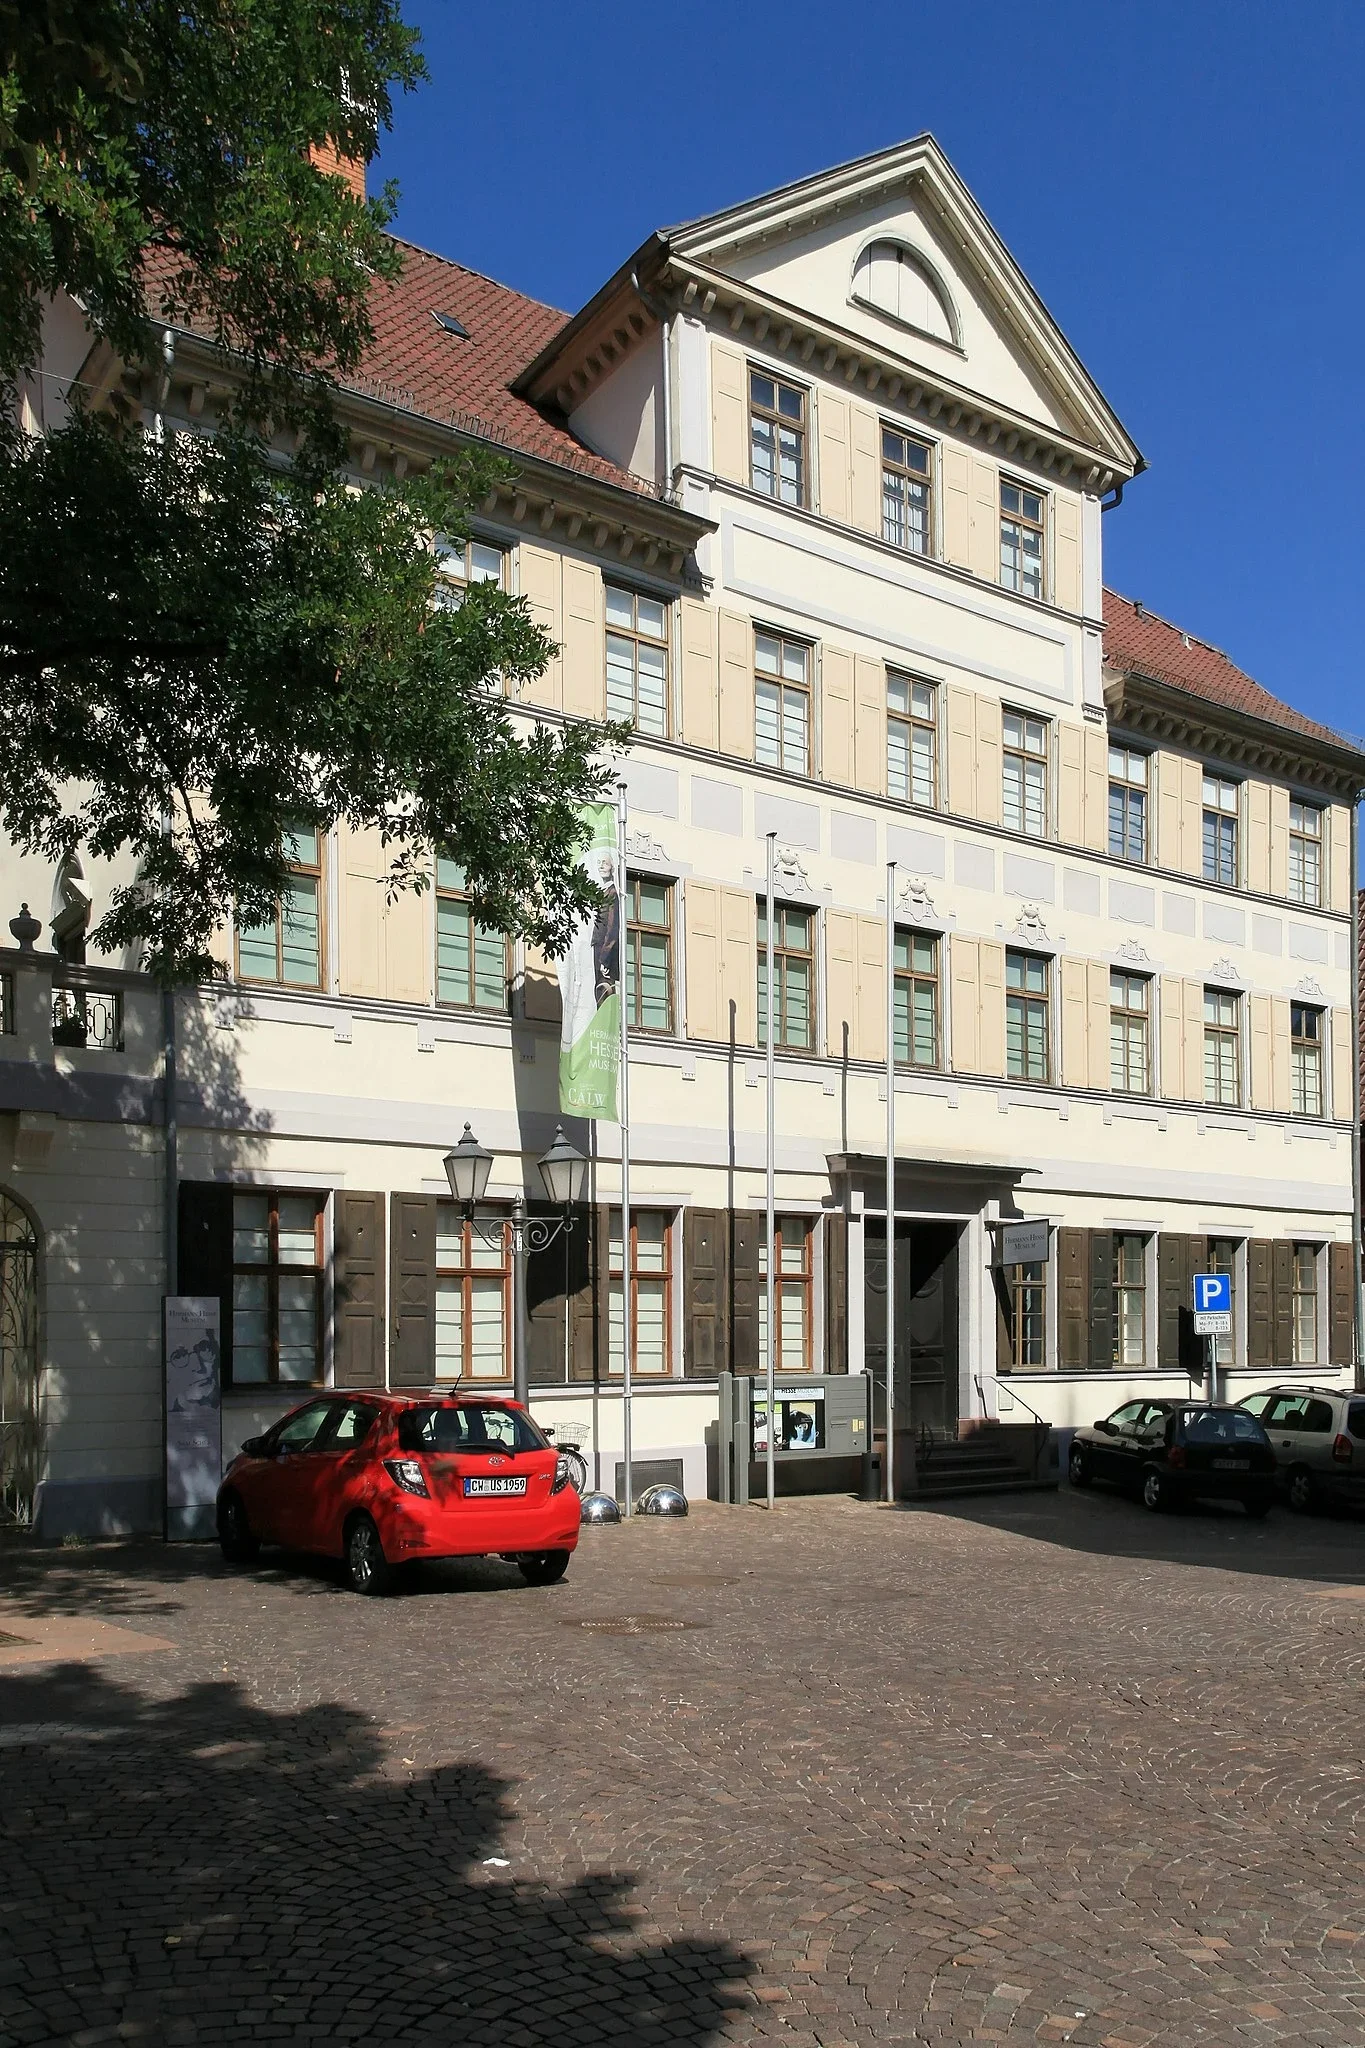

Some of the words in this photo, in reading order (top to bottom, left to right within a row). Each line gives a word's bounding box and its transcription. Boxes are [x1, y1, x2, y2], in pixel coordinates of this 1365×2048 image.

[589, 1040, 619, 1061] HESSE
[568, 1087, 608, 1107] CALW
[1202, 1279, 1222, 1308] P
[471, 1480, 483, 1492] CW
[490, 1479, 502, 1491] US
[503, 1479, 525, 1491] 1959
